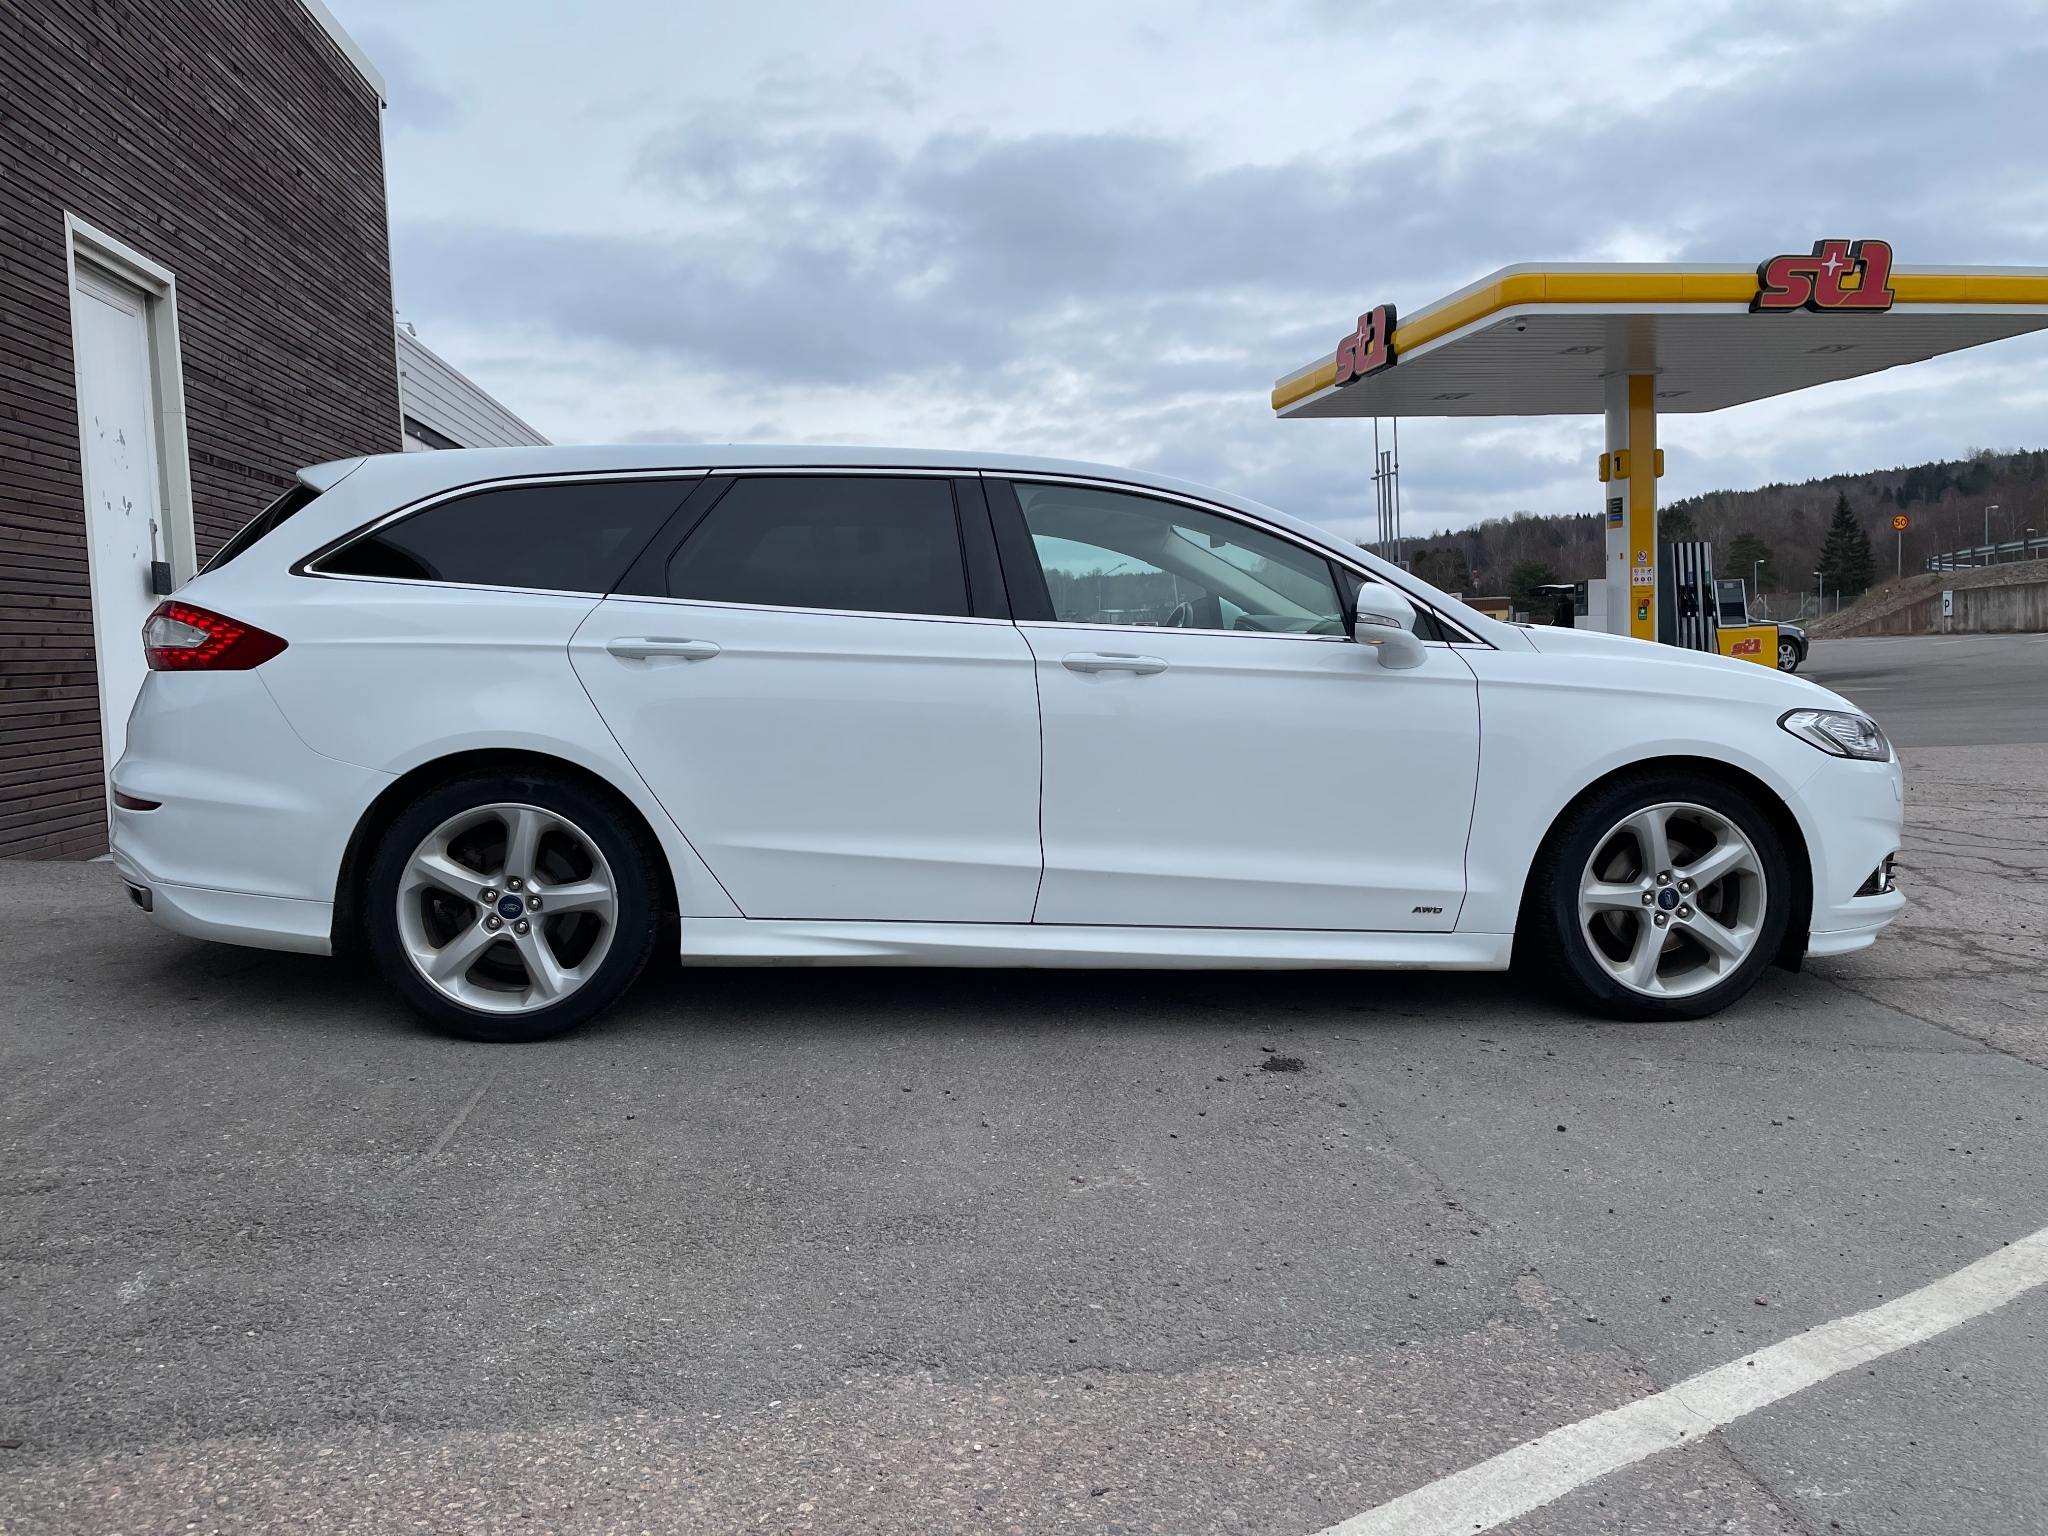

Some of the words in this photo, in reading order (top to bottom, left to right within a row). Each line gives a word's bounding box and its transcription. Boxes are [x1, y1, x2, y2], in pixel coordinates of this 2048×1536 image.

[1755, 239, 1894, 310] st1
[1614, 456, 1621, 472] 1
[1945, 599, 1950, 612] P
[1411, 906, 1443, 914] AWD
